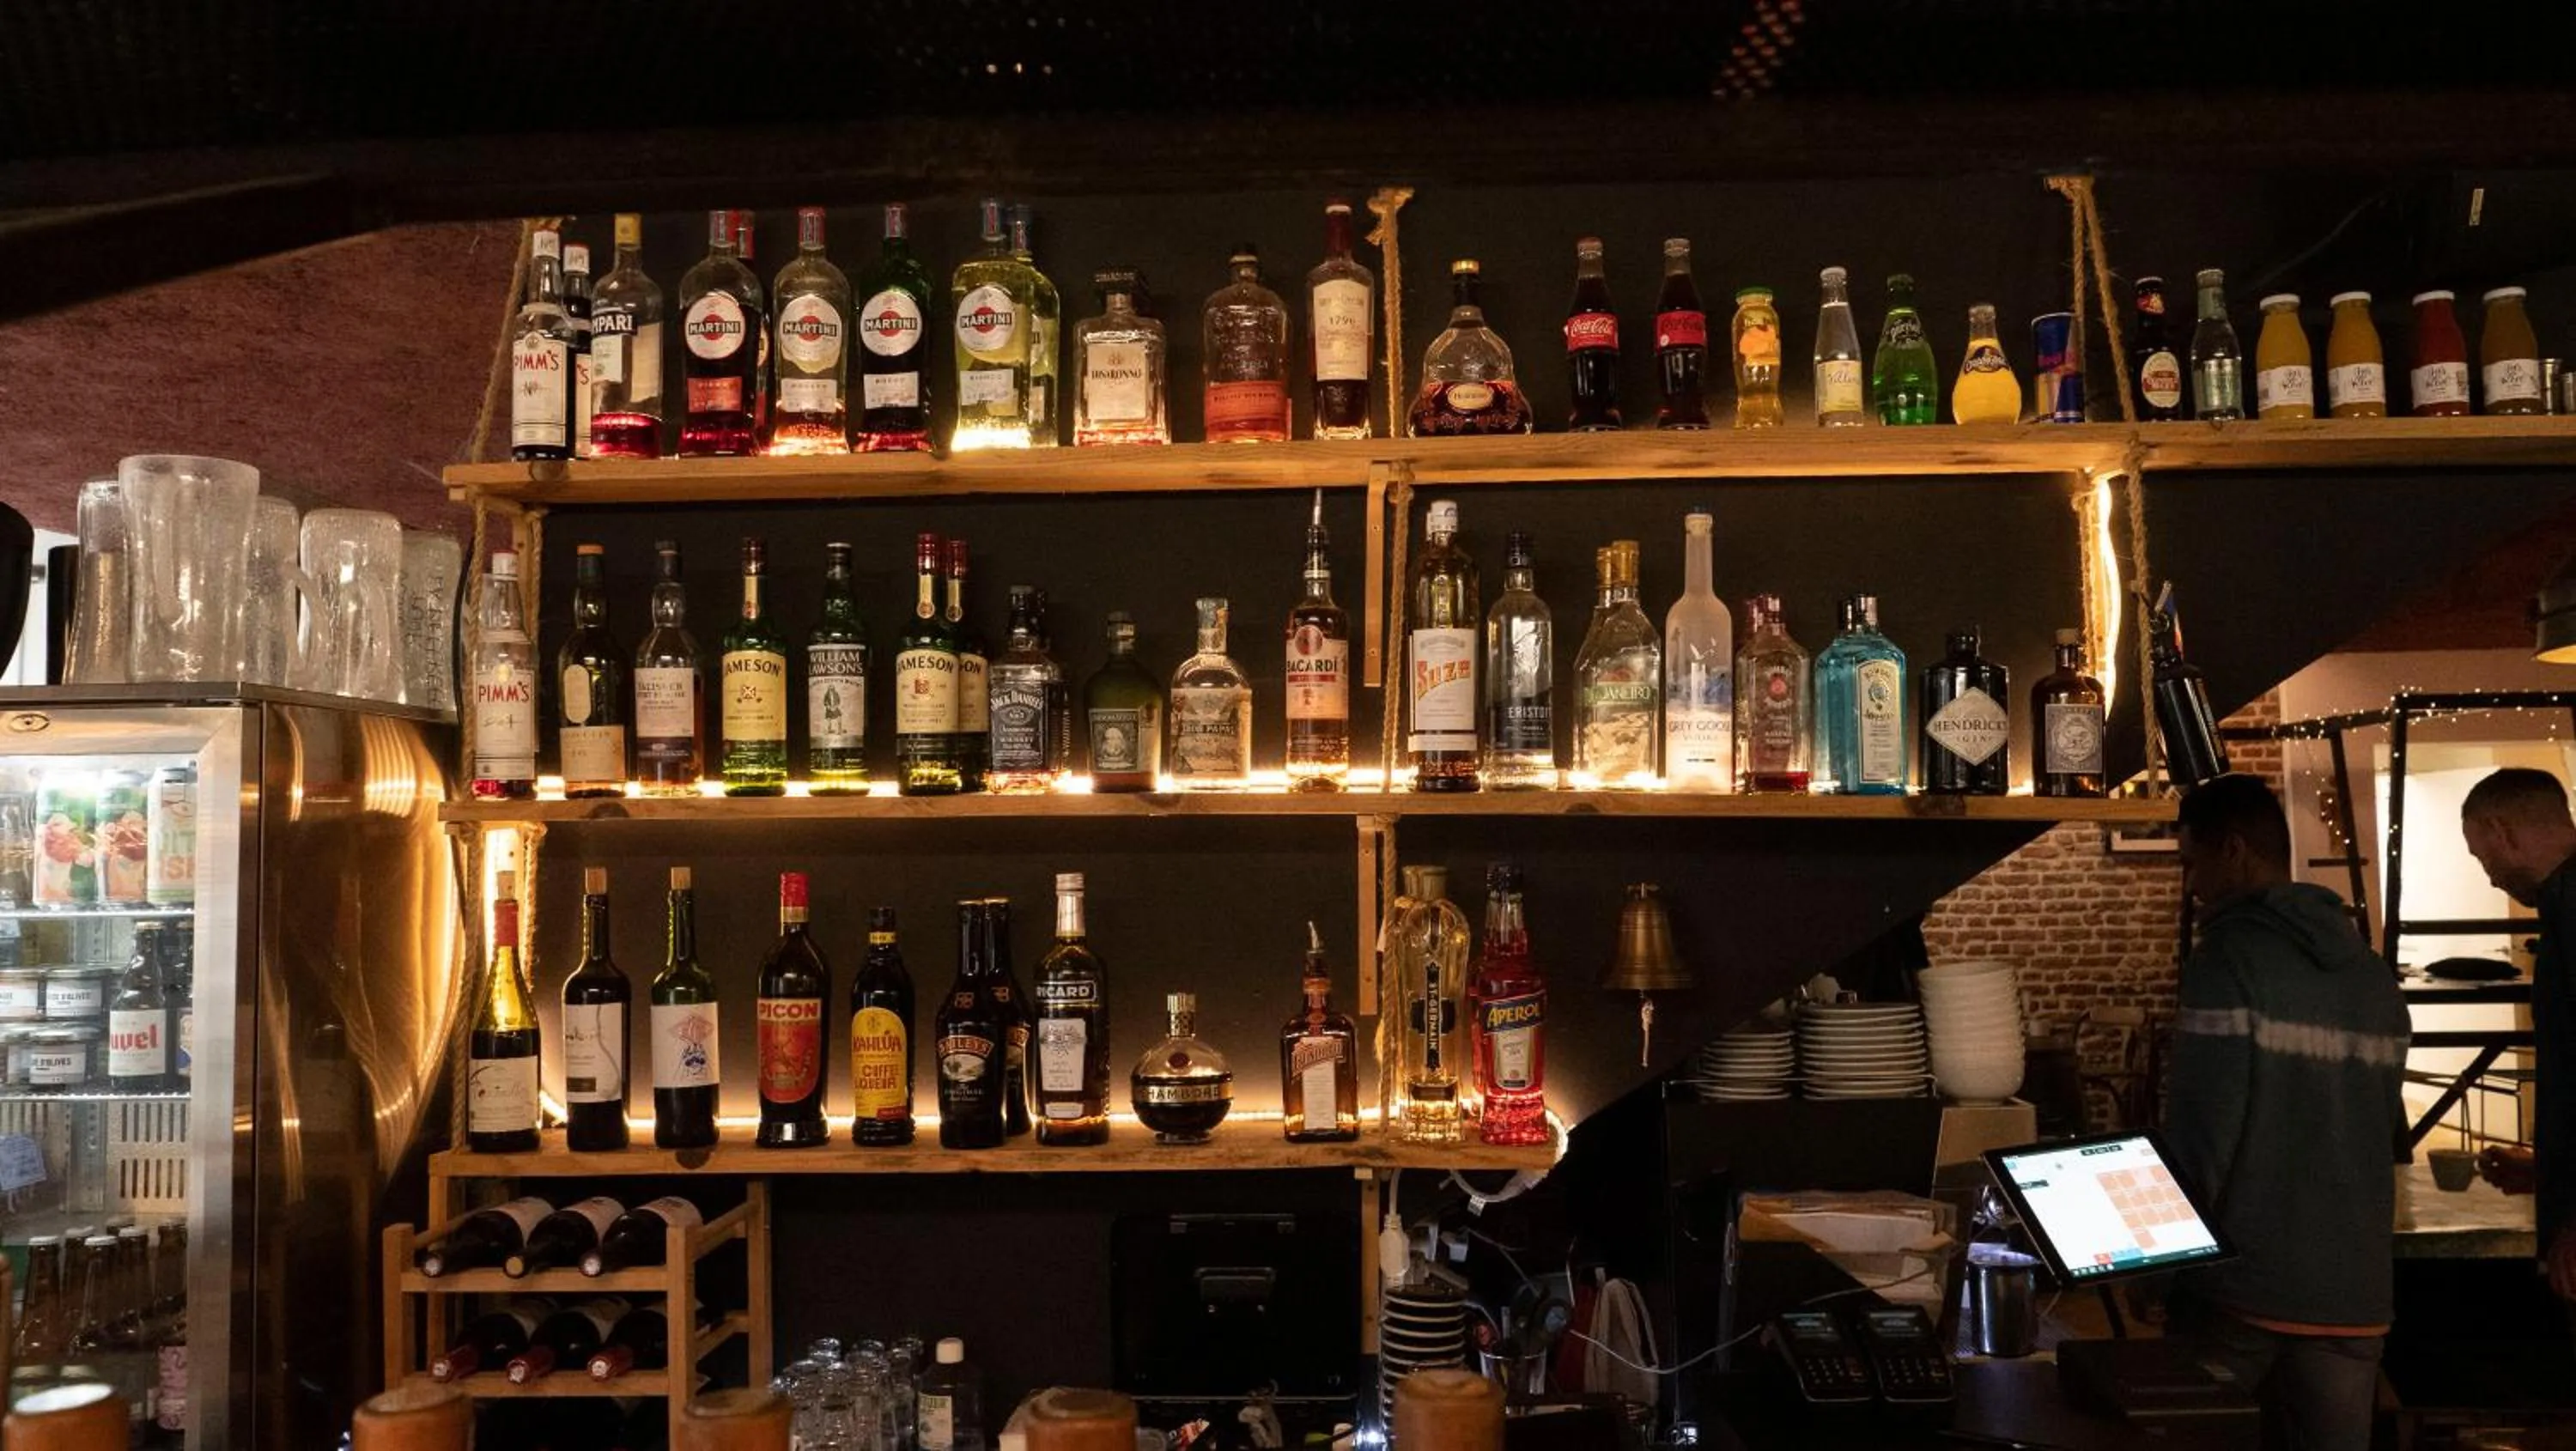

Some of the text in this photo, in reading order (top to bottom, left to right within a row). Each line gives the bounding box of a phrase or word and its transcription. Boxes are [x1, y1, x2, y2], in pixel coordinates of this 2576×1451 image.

[592, 314, 633, 332] MPARI
[689, 321, 741, 335] MARTINI
[783, 321, 837, 337] MARTINI
[866, 318, 917, 331] MARTINI
[960, 313, 1012, 329] MARTINI
[1571, 317, 1613, 338] Coca-Cola
[515, 349, 560, 371] PIMM'S
[810, 652, 860, 664] WILLIAM
[726, 659, 781, 677] AMESON
[478, 682, 530, 703] PIMM'S
[1934, 719, 2008, 733] HENDRICK
[1961, 734, 1987, 743] GIN
[1037, 986, 1091, 999] RICARD
[758, 1003, 817, 1018] PICON
[1487, 1002, 1540, 1029] APEROL
[110, 1023, 159, 1051] uvel
